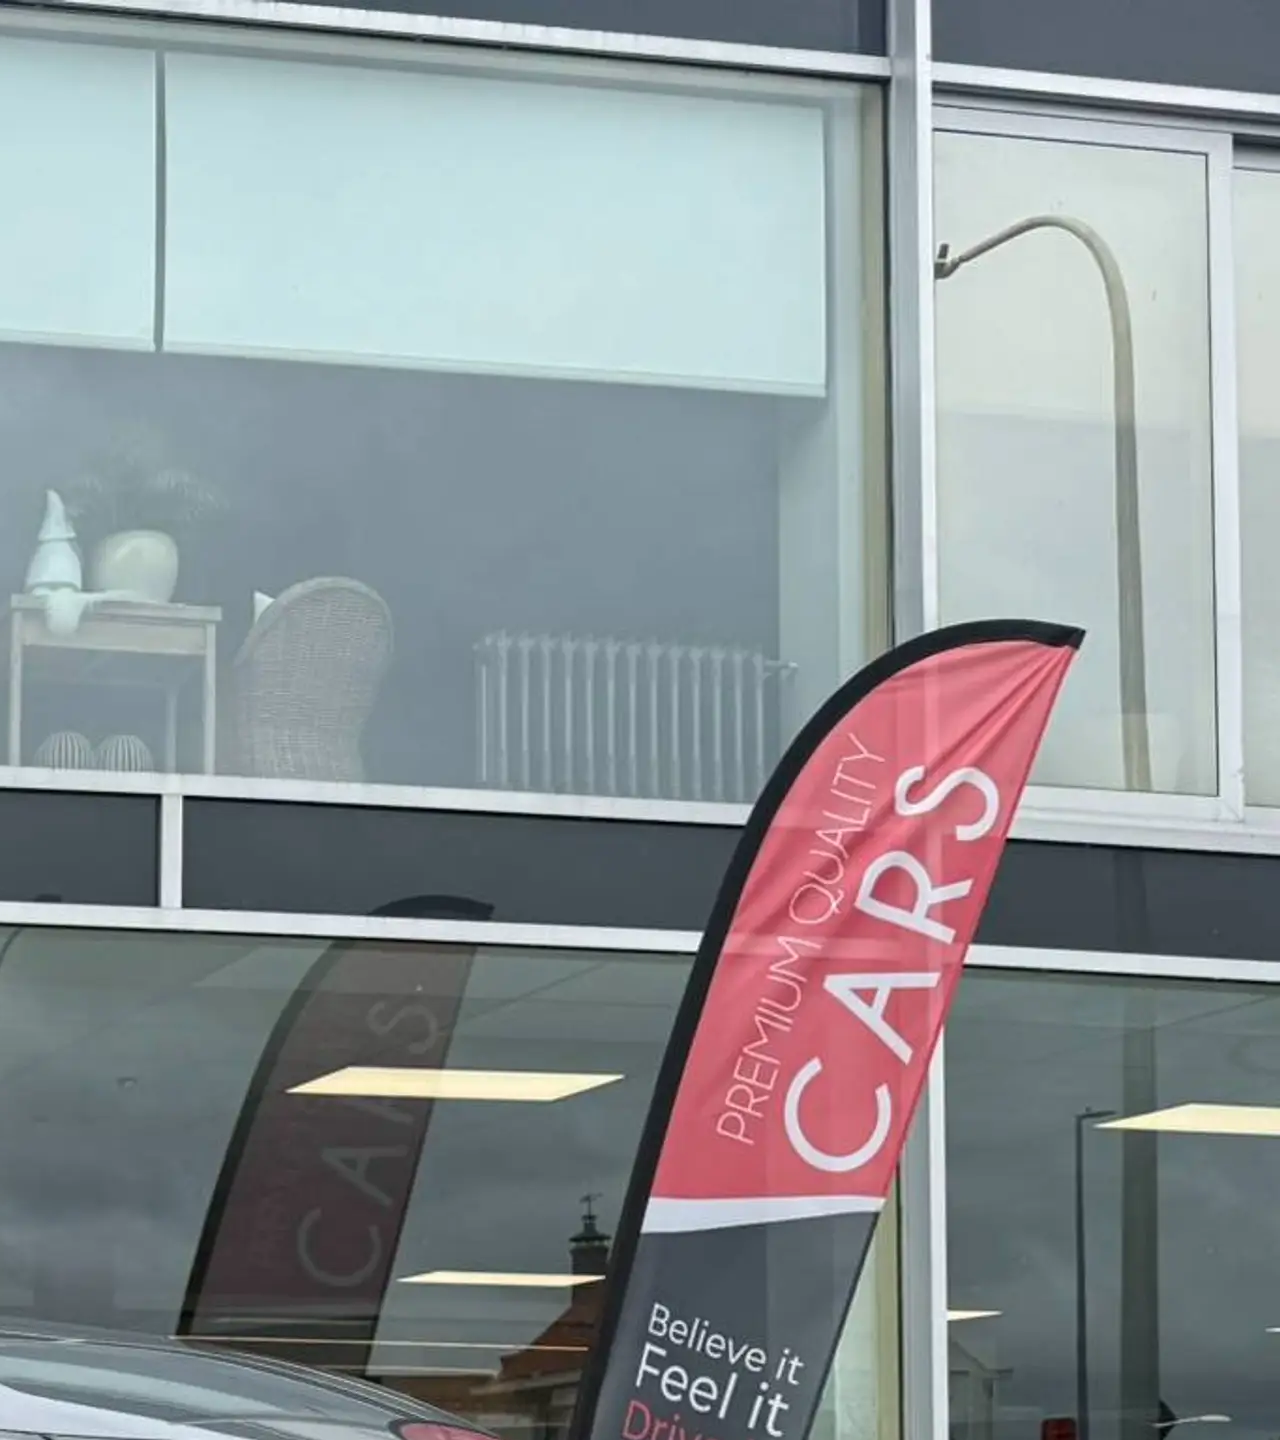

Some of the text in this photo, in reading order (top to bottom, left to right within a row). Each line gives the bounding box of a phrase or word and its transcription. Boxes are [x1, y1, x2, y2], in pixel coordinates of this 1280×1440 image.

[716, 732, 887, 1145] PREMIUM QUALITY
[783, 764, 1000, 1173] CARS
[296, 1000, 439, 1288] CAS
[635, 1342, 790, 1438] Feel it
[647, 1302, 804, 1386] Believe it
